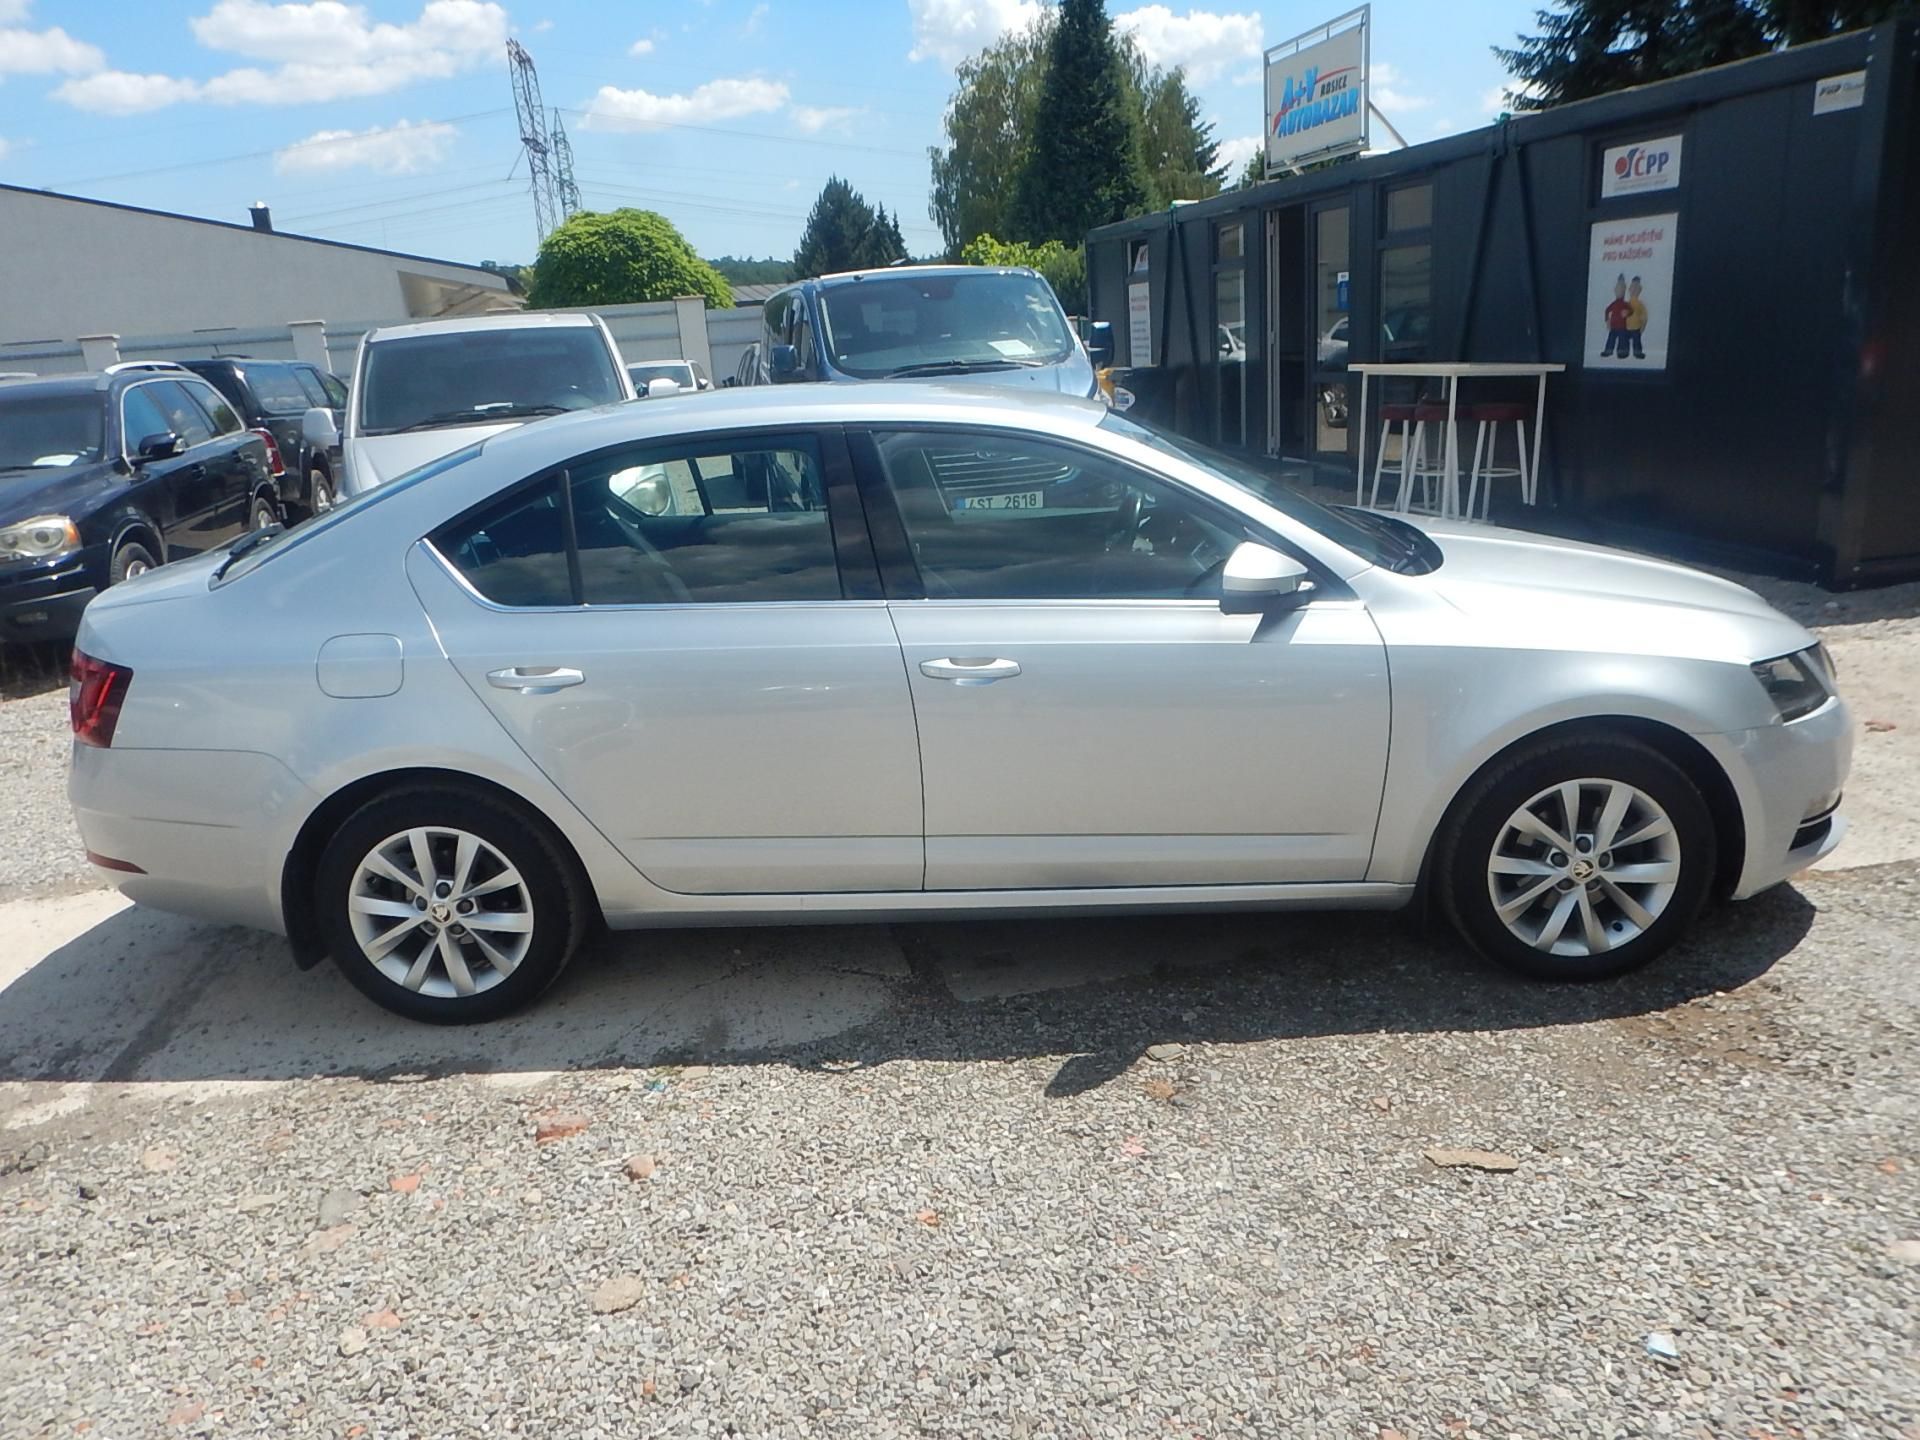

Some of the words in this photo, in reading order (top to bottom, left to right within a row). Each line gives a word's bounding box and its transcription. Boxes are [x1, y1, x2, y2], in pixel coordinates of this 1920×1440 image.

[1278, 87, 1358, 138] AUTOBAZAR
[1634, 150, 1669, 176] ČPP
[1004, 493, 1037, 509] 2618
